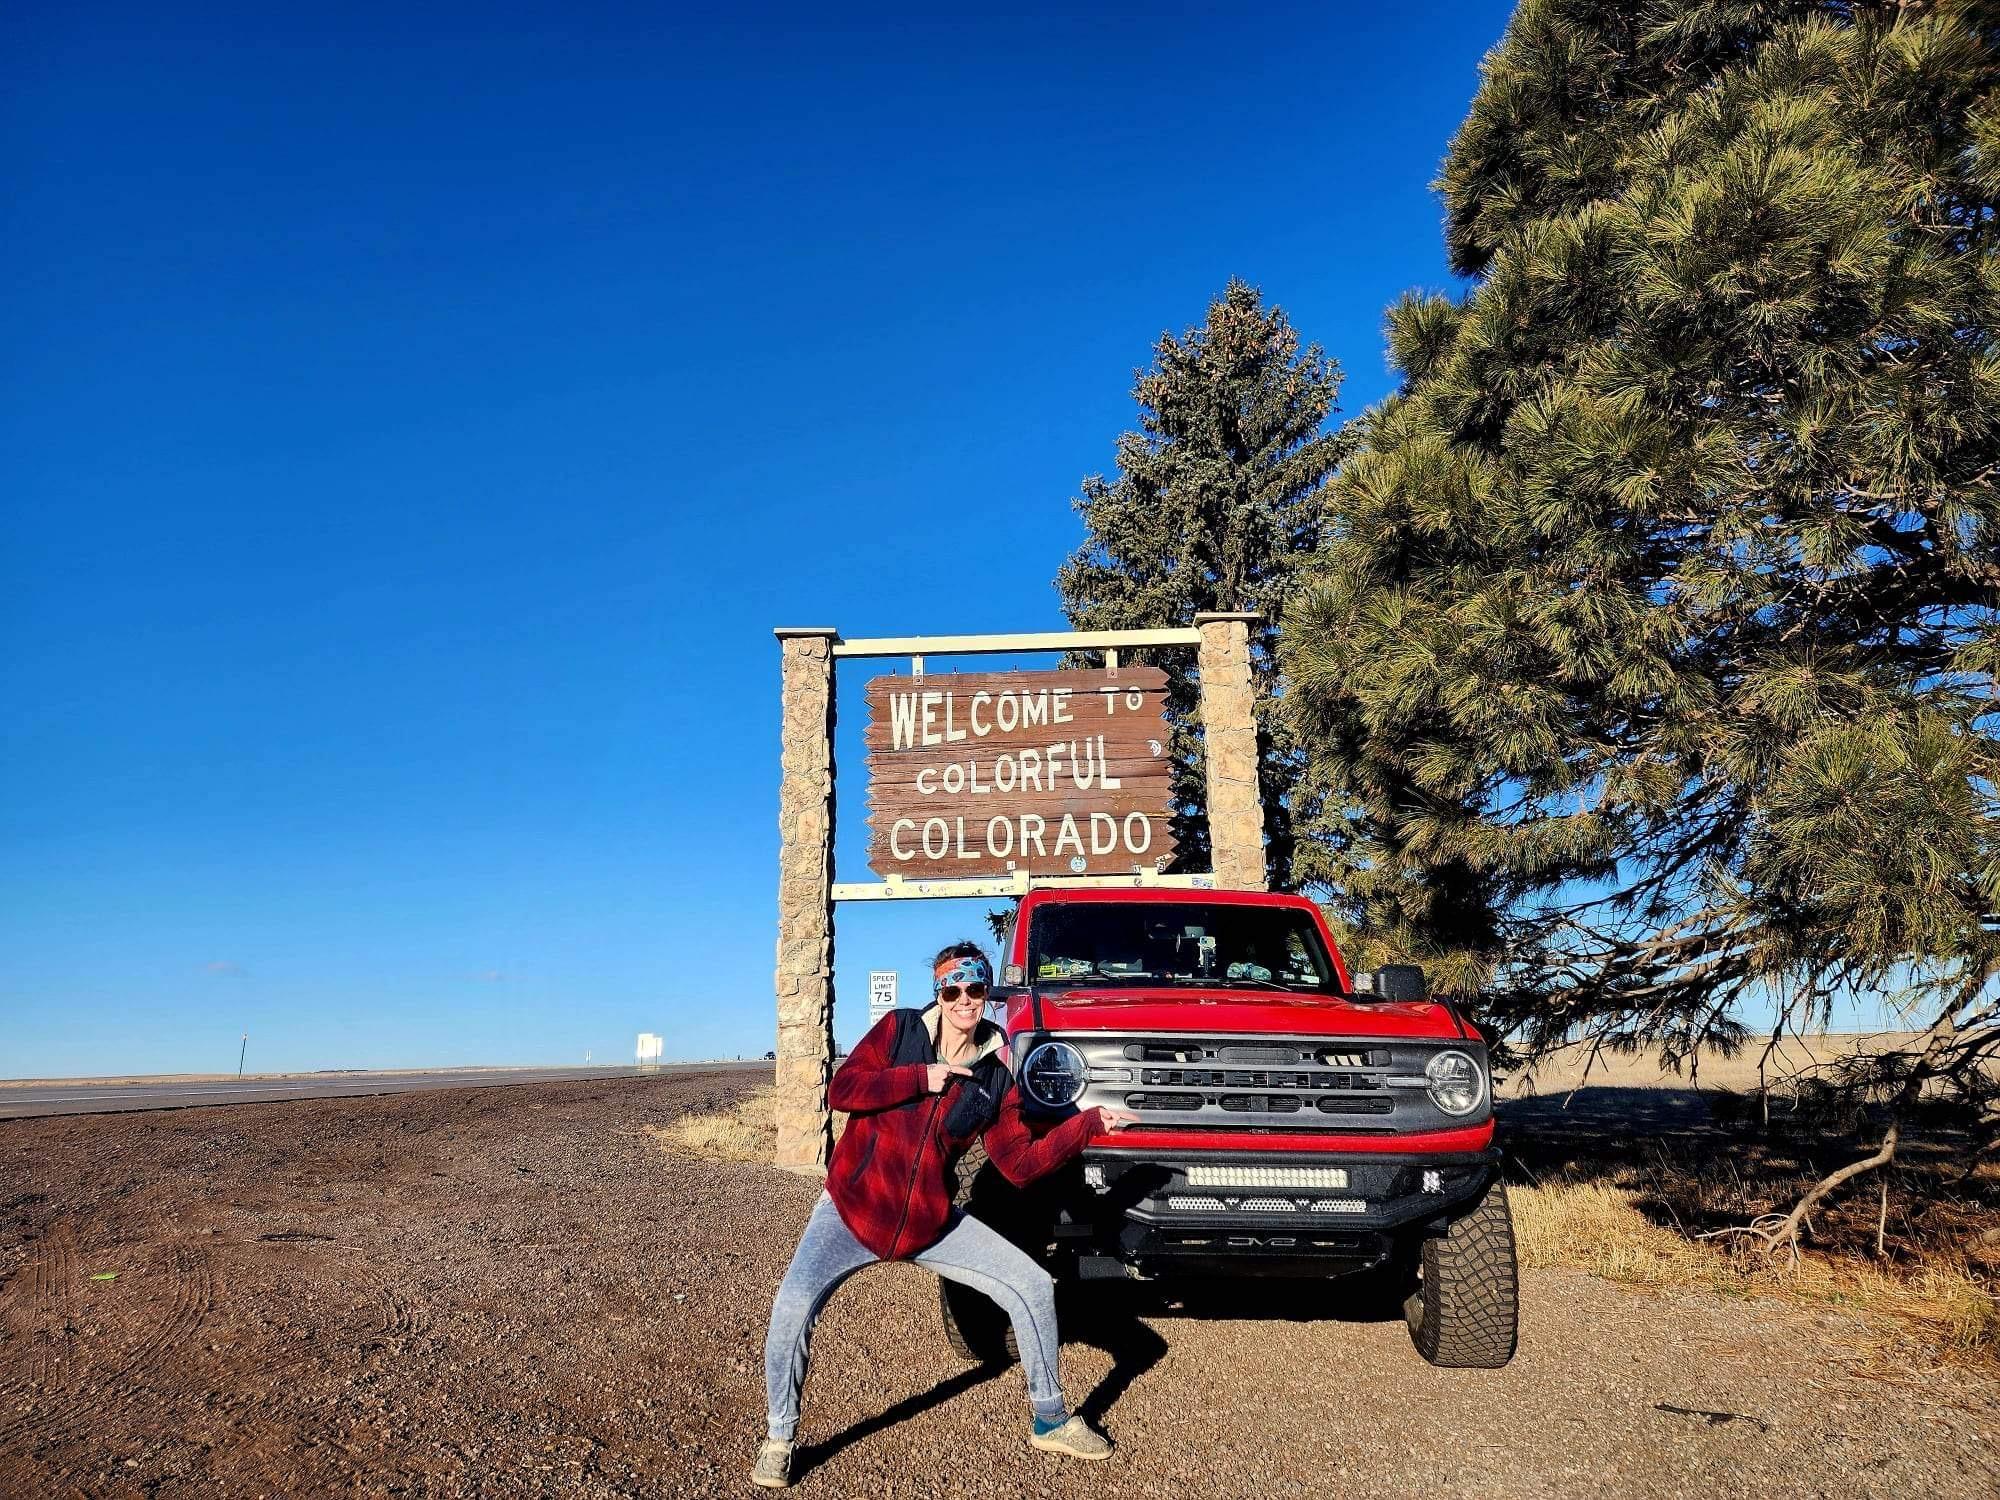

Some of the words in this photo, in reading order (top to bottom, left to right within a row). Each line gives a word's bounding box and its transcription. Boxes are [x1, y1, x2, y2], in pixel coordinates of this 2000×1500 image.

[889, 687, 1074, 751] WELCOME
[1099, 685, 1144, 715] TO
[916, 734, 1122, 795] COLORFUL
[890, 811, 1151, 860] COLORADO
[874, 991, 892, 1002] 75
